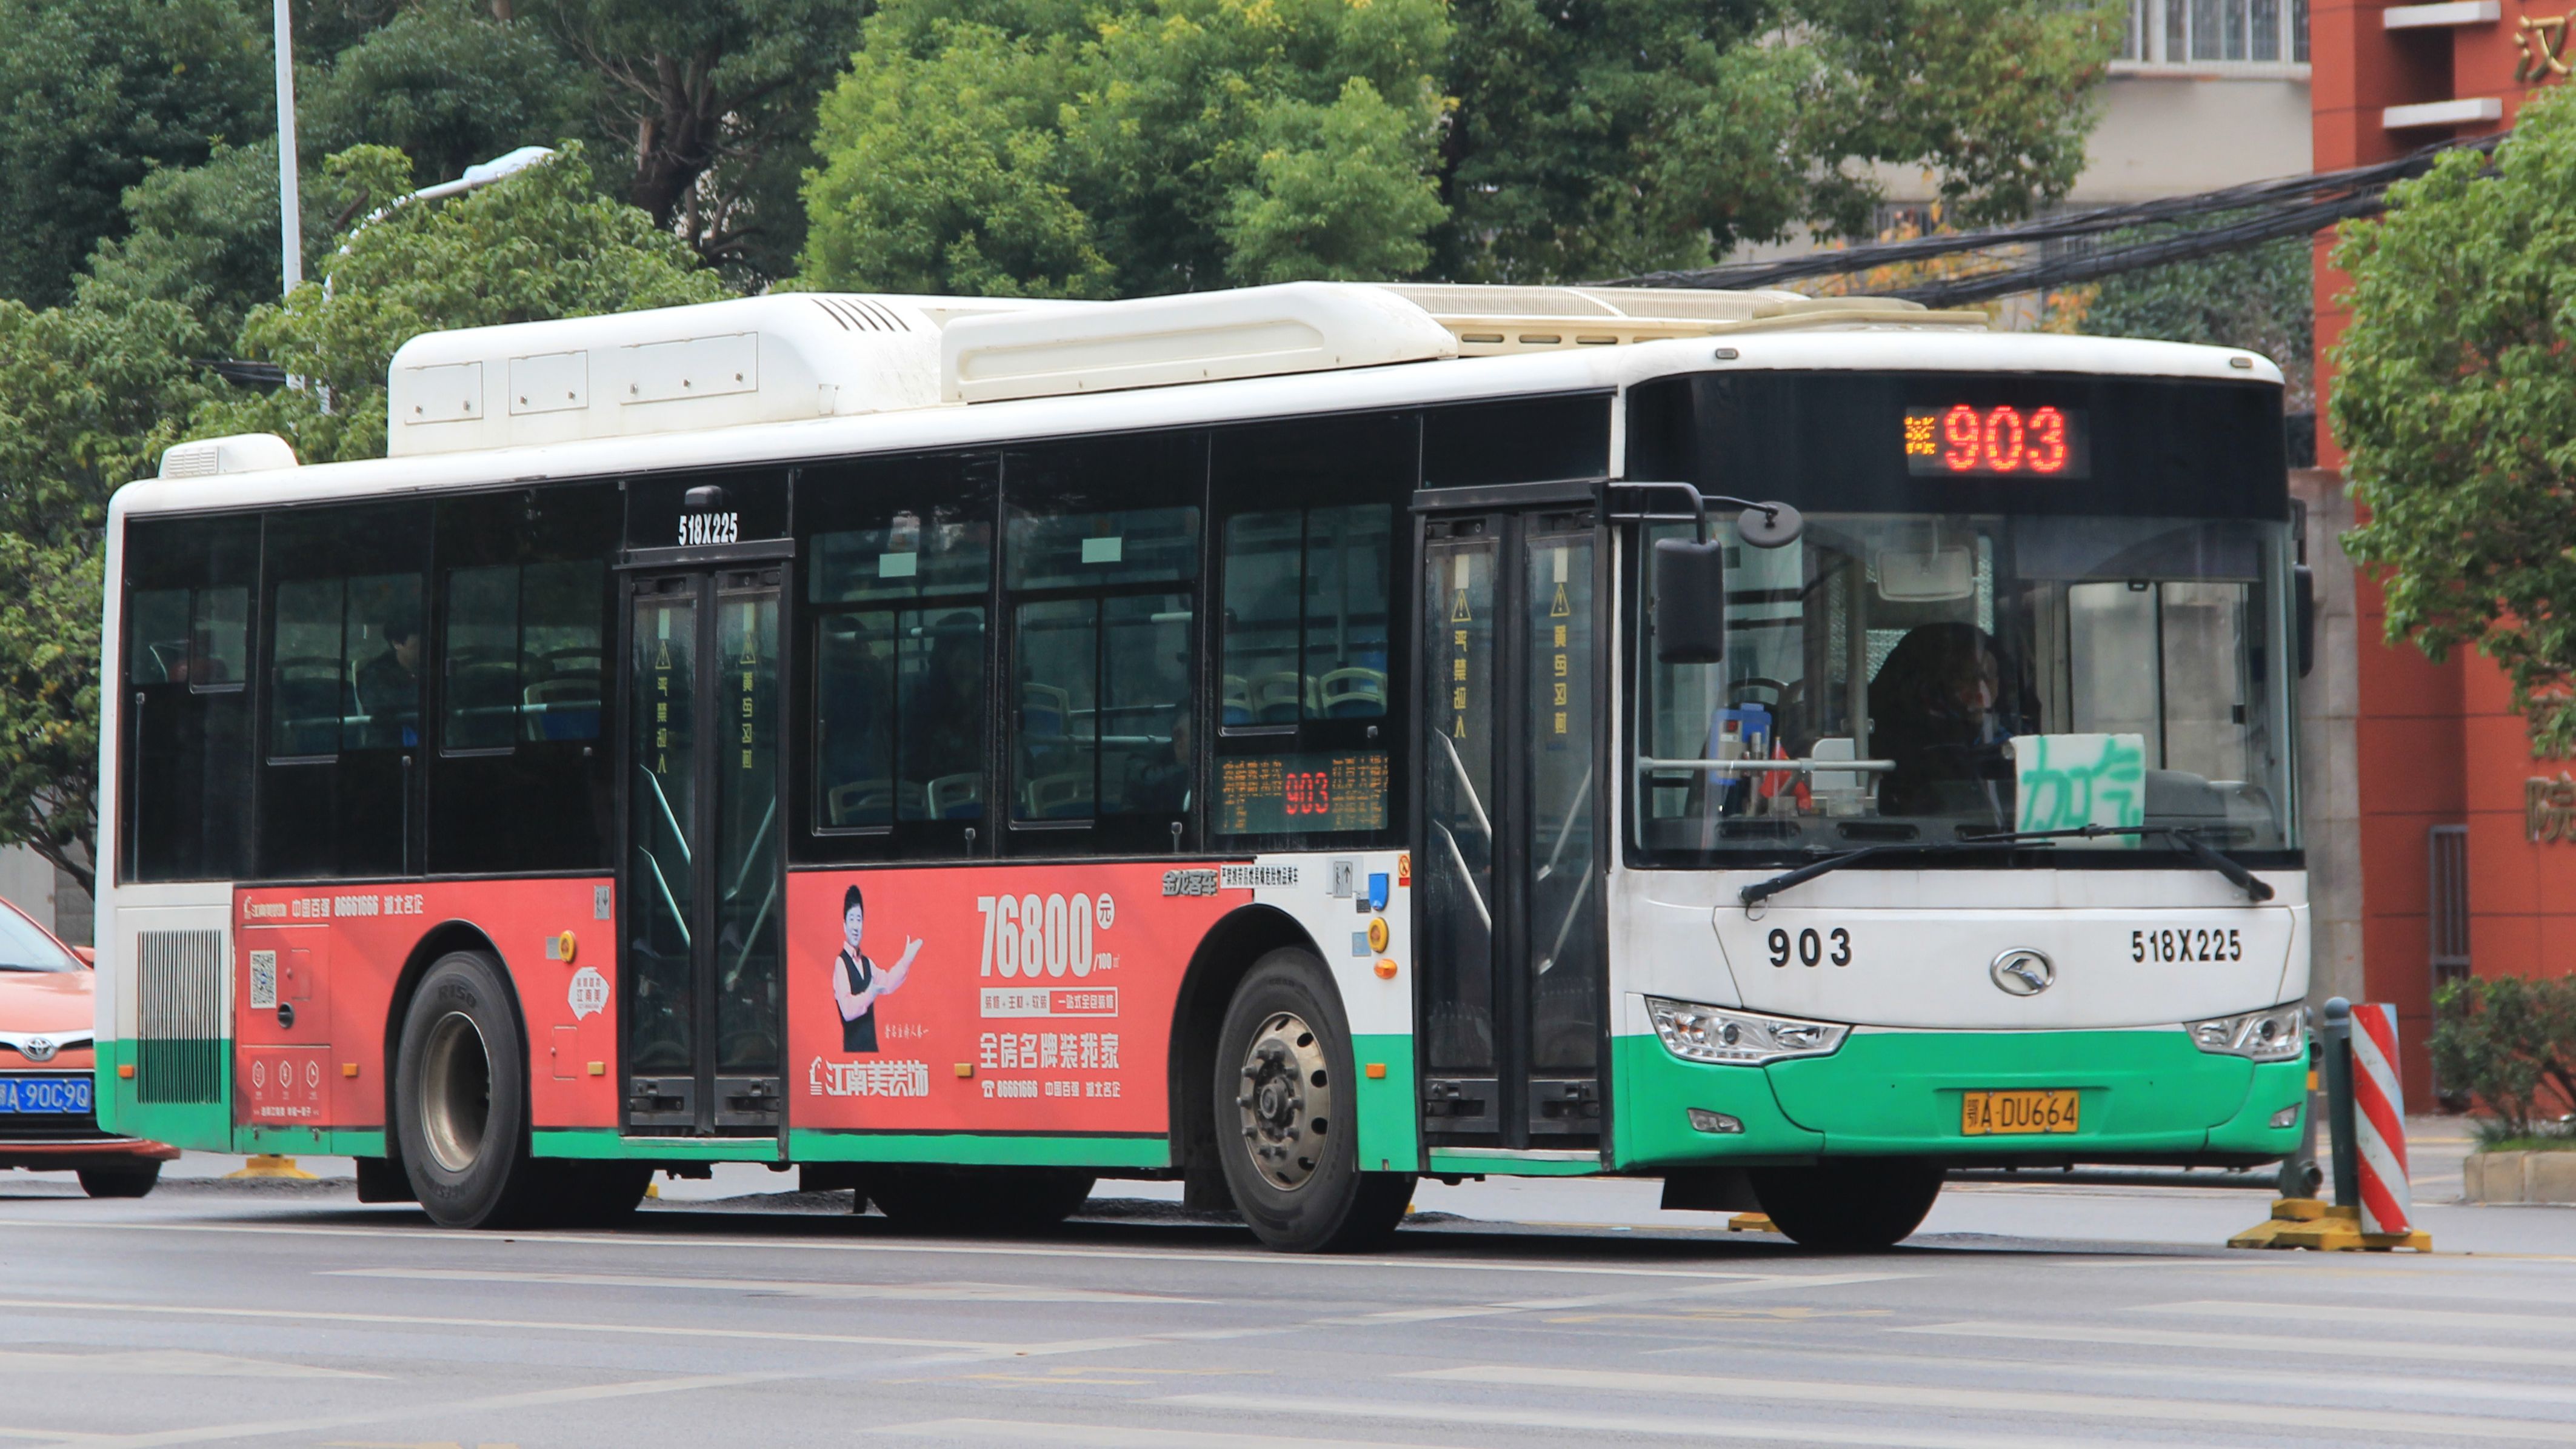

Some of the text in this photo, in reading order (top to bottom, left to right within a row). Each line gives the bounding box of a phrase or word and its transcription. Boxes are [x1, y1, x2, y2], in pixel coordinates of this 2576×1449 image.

[1943, 404, 2067, 472] 903
[678, 512, 738, 546] 518X225
[1286, 772, 1329, 815] 903
[2021, 737, 2142, 848] 加气
[1162, 869, 1217, 896] 金龙客车
[978, 893, 1092, 978] 76800
[1769, 928, 1851, 967] 903
[2132, 929, 2242, 963] 518X225
[980, 1033, 1119, 1068] 全房名牌装我家
[826, 1060, 929, 1096] 江南美装饰
